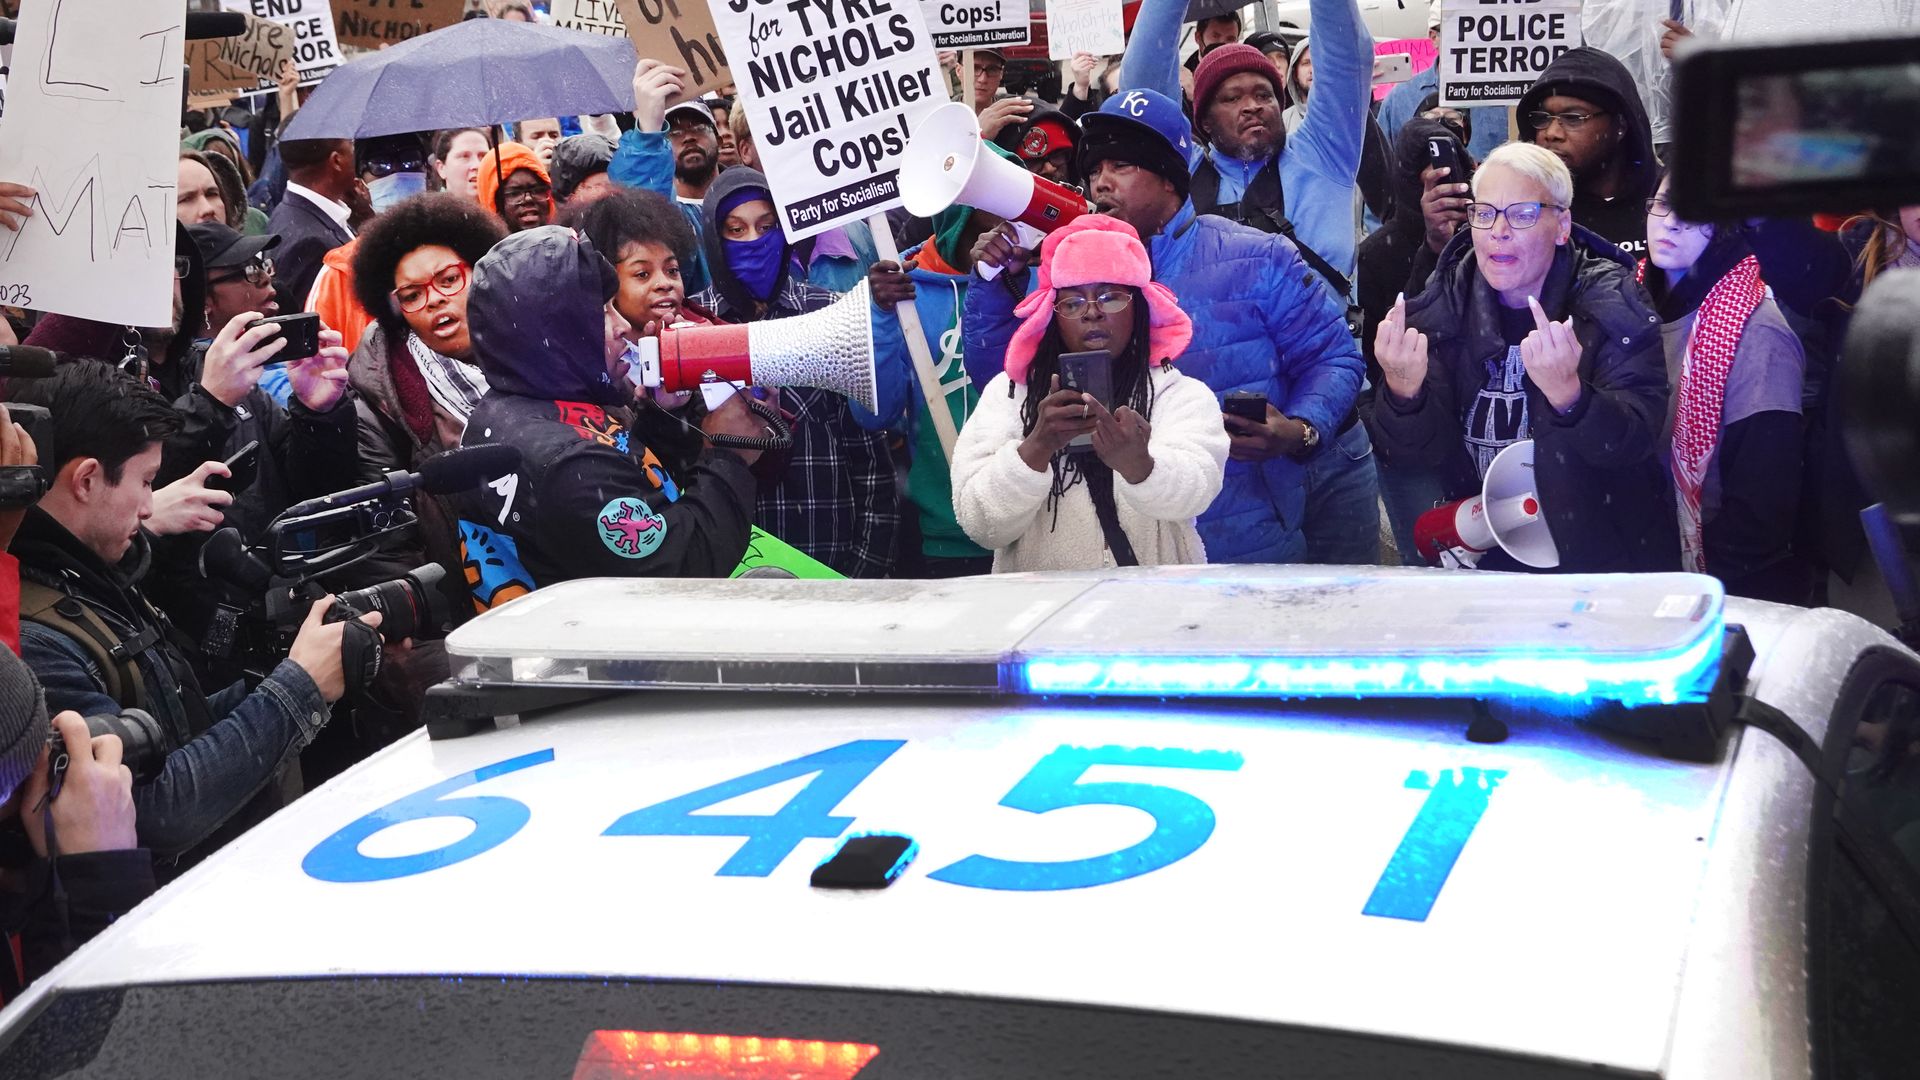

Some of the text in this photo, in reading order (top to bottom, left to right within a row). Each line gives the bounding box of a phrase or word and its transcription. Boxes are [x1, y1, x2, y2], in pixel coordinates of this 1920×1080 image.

[251, 0, 302, 18] END
[940, 1, 1002, 28] Cops!
[1051, 11, 1097, 35] Abolish
[749, 12, 783, 57] for
[938, 35, 948, 45] for
[949, 33, 983, 44] Socialism
[984, 32, 990, 42] &
[991, 30, 1026, 41] Liberation
[1458, 13, 1565, 42] POLICE
[747, 14, 915, 98] NICHOLS
[1120, 92, 1148, 117] KC
[1448, 86, 1469, 98] Party
[1471, 85, 1482, 96] for
[1483, 84, 1522, 96] Socialism
[766, 67, 932, 146] Jail Killer
[813, 113, 911, 177] Cops!
[791, 203, 823, 224] Party
[823, 198, 840, 214] for
[840, 179, 896, 208] Socialism
